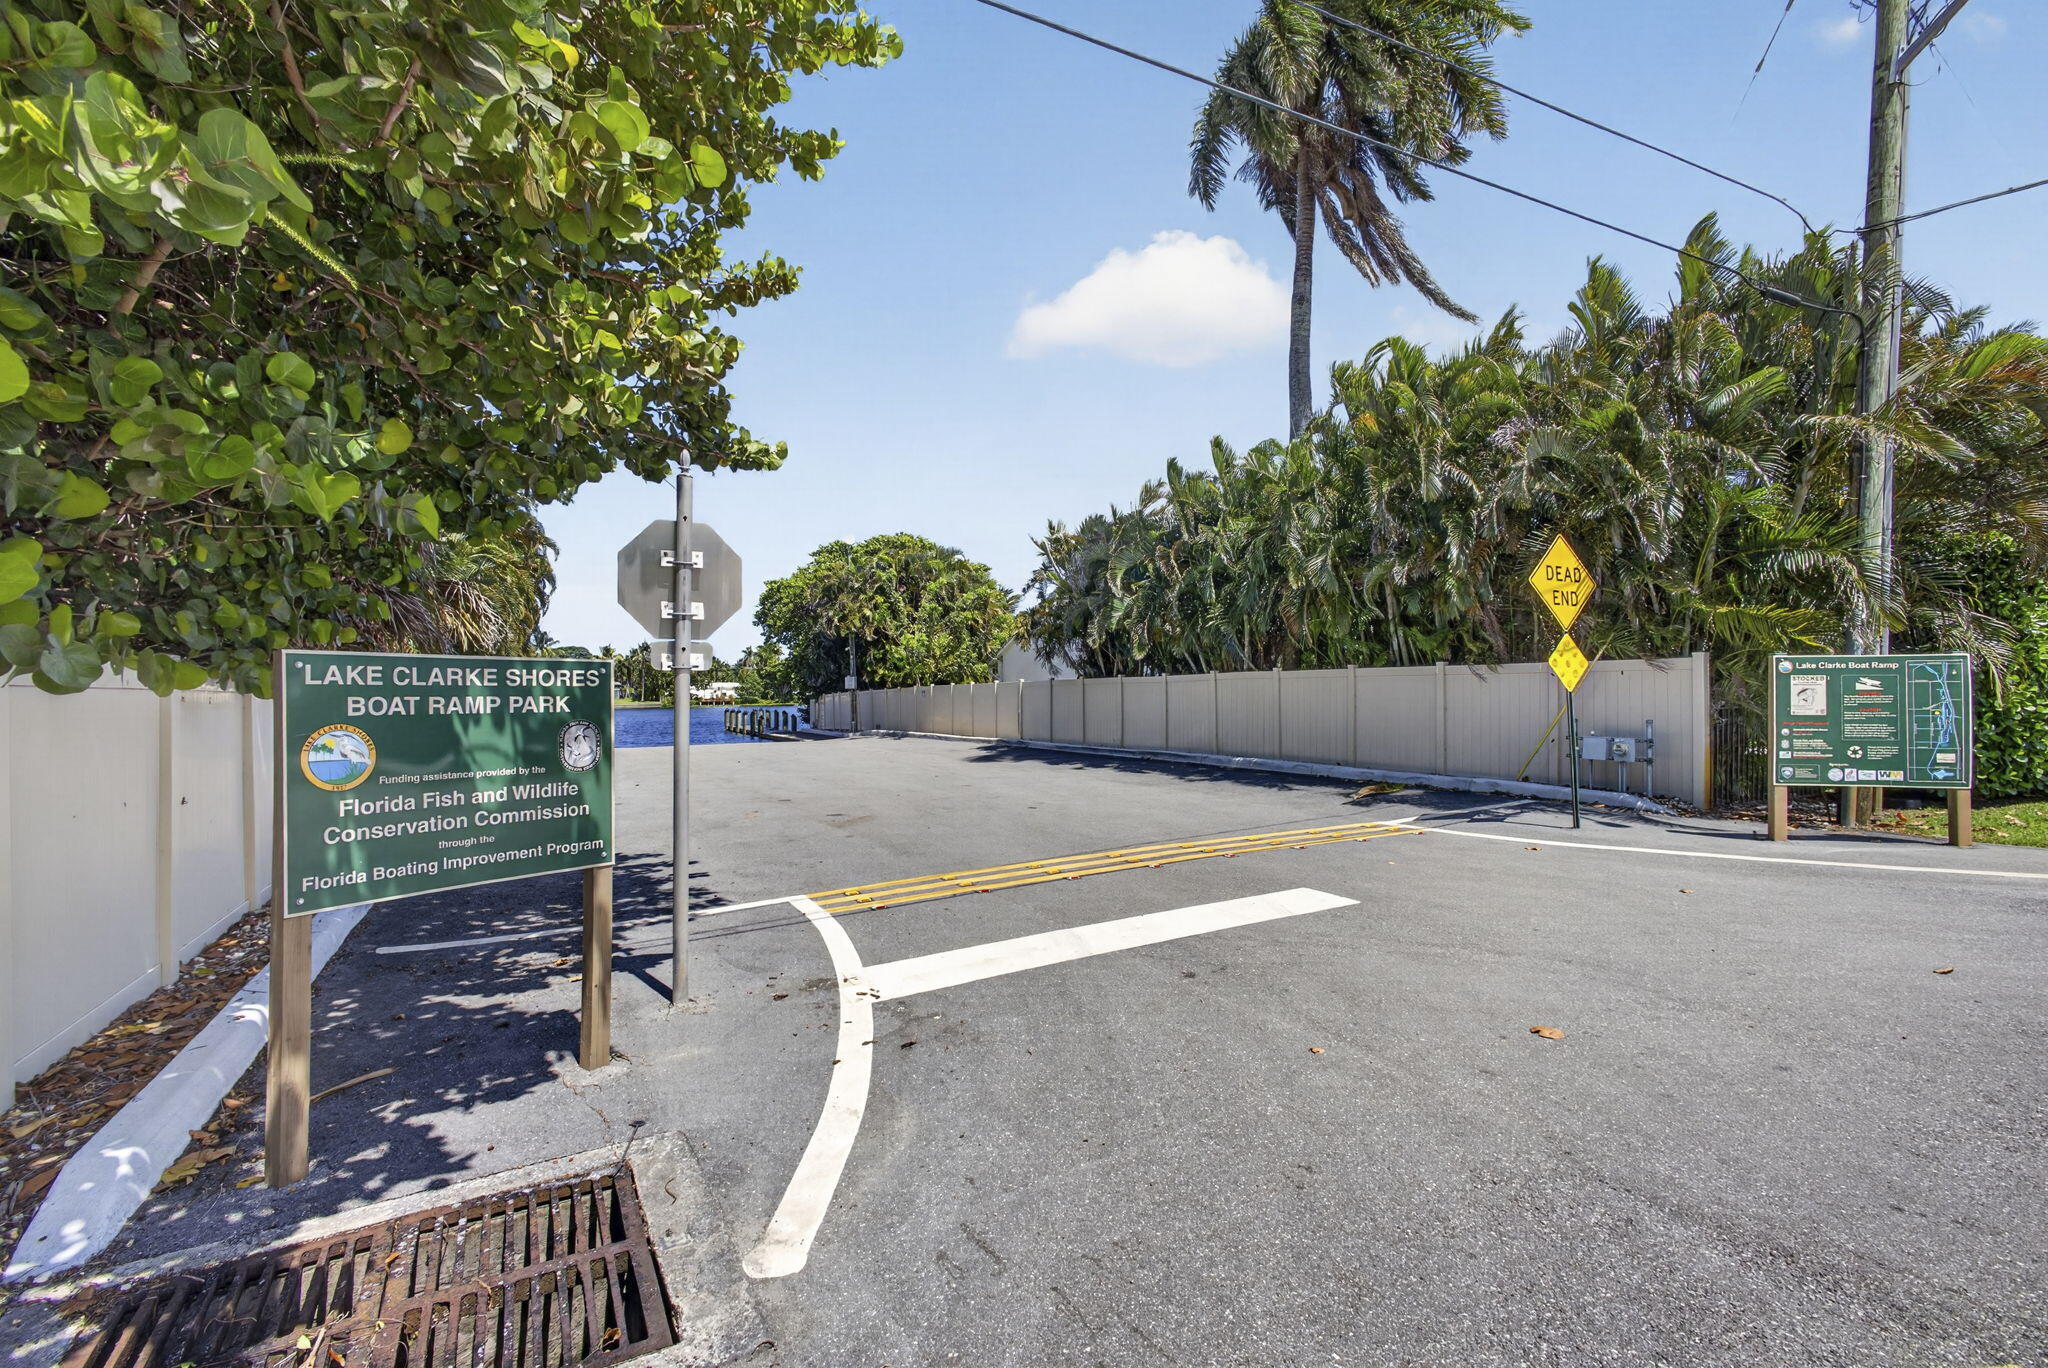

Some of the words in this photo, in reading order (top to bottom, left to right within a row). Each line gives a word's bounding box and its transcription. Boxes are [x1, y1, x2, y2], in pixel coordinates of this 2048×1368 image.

[1546, 565, 1581, 583] DEAD
[1553, 590, 1578, 607] END
[304, 664, 384, 686] LAKE
[392, 667, 498, 686] CLARKE
[506, 668, 600, 687] SHORES
[1818, 661, 1846, 669] Clarke
[1849, 661, 1871, 670] Boat
[1872, 661, 1900, 671] Ramp
[347, 696, 420, 716] BOAT
[428, 696, 501, 714] RAMP
[509, 696, 571, 713] PARK
[317, 725, 349, 736] CLARKE
[379, 775, 421, 785] Funding
[422, 772, 474, 781] assistance
[476, 767, 517, 779] provided
[519, 766, 530, 777] by
[531, 766, 546, 774] the
[339, 795, 416, 817] Florida
[423, 790, 465, 809] Fish
[471, 786, 508, 803] and
[512, 781, 579, 799] Wildlife
[323, 815, 468, 845] Conservation
[474, 803, 590, 827] Commission
[438, 839, 477, 849] through
[479, 835, 495, 843] the
[302, 871, 368, 893] Florida
[373, 860, 438, 881] Boating
[443, 846, 543, 870] Improvement
[547, 838, 604, 856] Program
